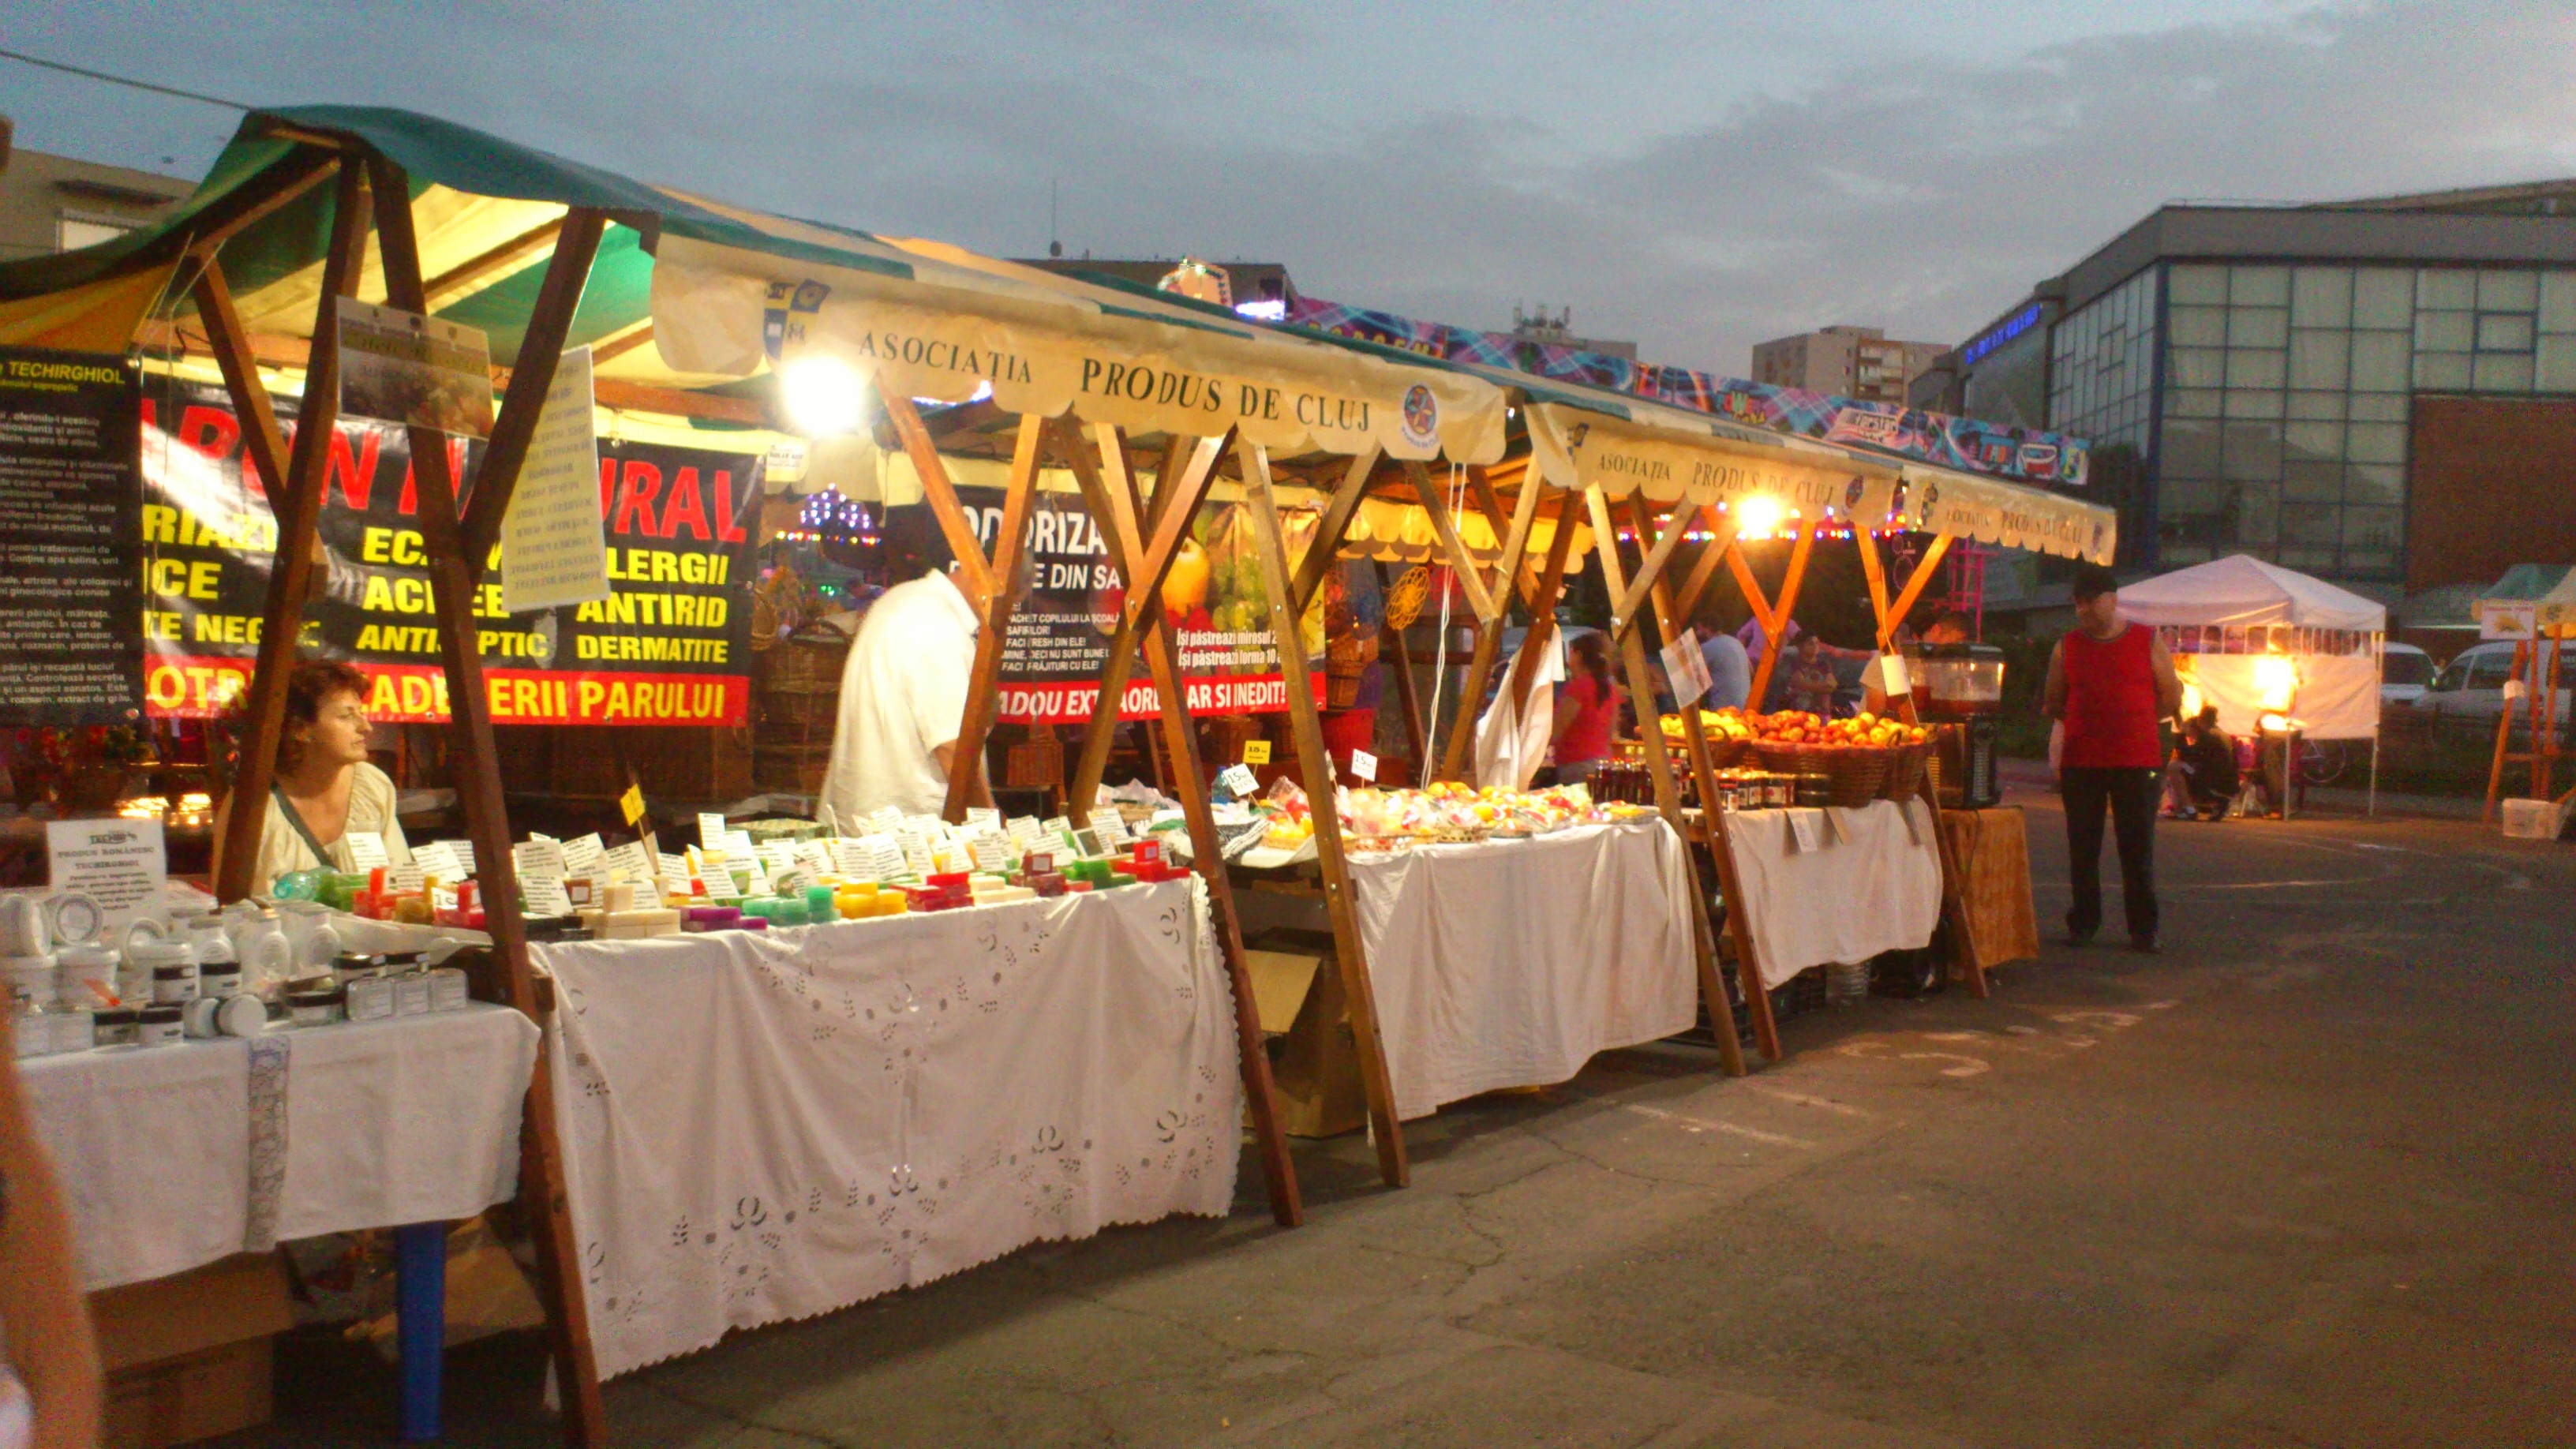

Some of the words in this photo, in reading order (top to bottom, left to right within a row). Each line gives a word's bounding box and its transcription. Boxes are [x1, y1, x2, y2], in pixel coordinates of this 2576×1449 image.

[9, 361, 125, 385] TECHIRGHIOL
[1081, 357, 1222, 413] PRODUS
[1240, 384, 1280, 421] DE
[1296, 393, 1370, 432] CLUJ
[605, 547, 729, 585] LERGII
[1050, 564, 1088, 590] DIN
[575, 591, 728, 628] ANTIRID
[1039, 612, 1079, 623] COPILULUI
[1080, 613, 1090, 622] LA
[356, 624, 548, 658] ANTIPTIC
[576, 635, 729, 664] DERMATITE
[1005, 637, 1026, 647] FACI
[1054, 636, 1068, 646] DIN
[1069, 636, 1086, 646] ELE!
[1061, 649, 1083, 658] SUNT
[1069, 661, 1081, 669] CU
[1082, 660, 1100, 669] ELE!
[579, 680, 726, 719] PARULUI
[1215, 683, 1231, 708] SI
[1234, 680, 1286, 708] INEDIT!
